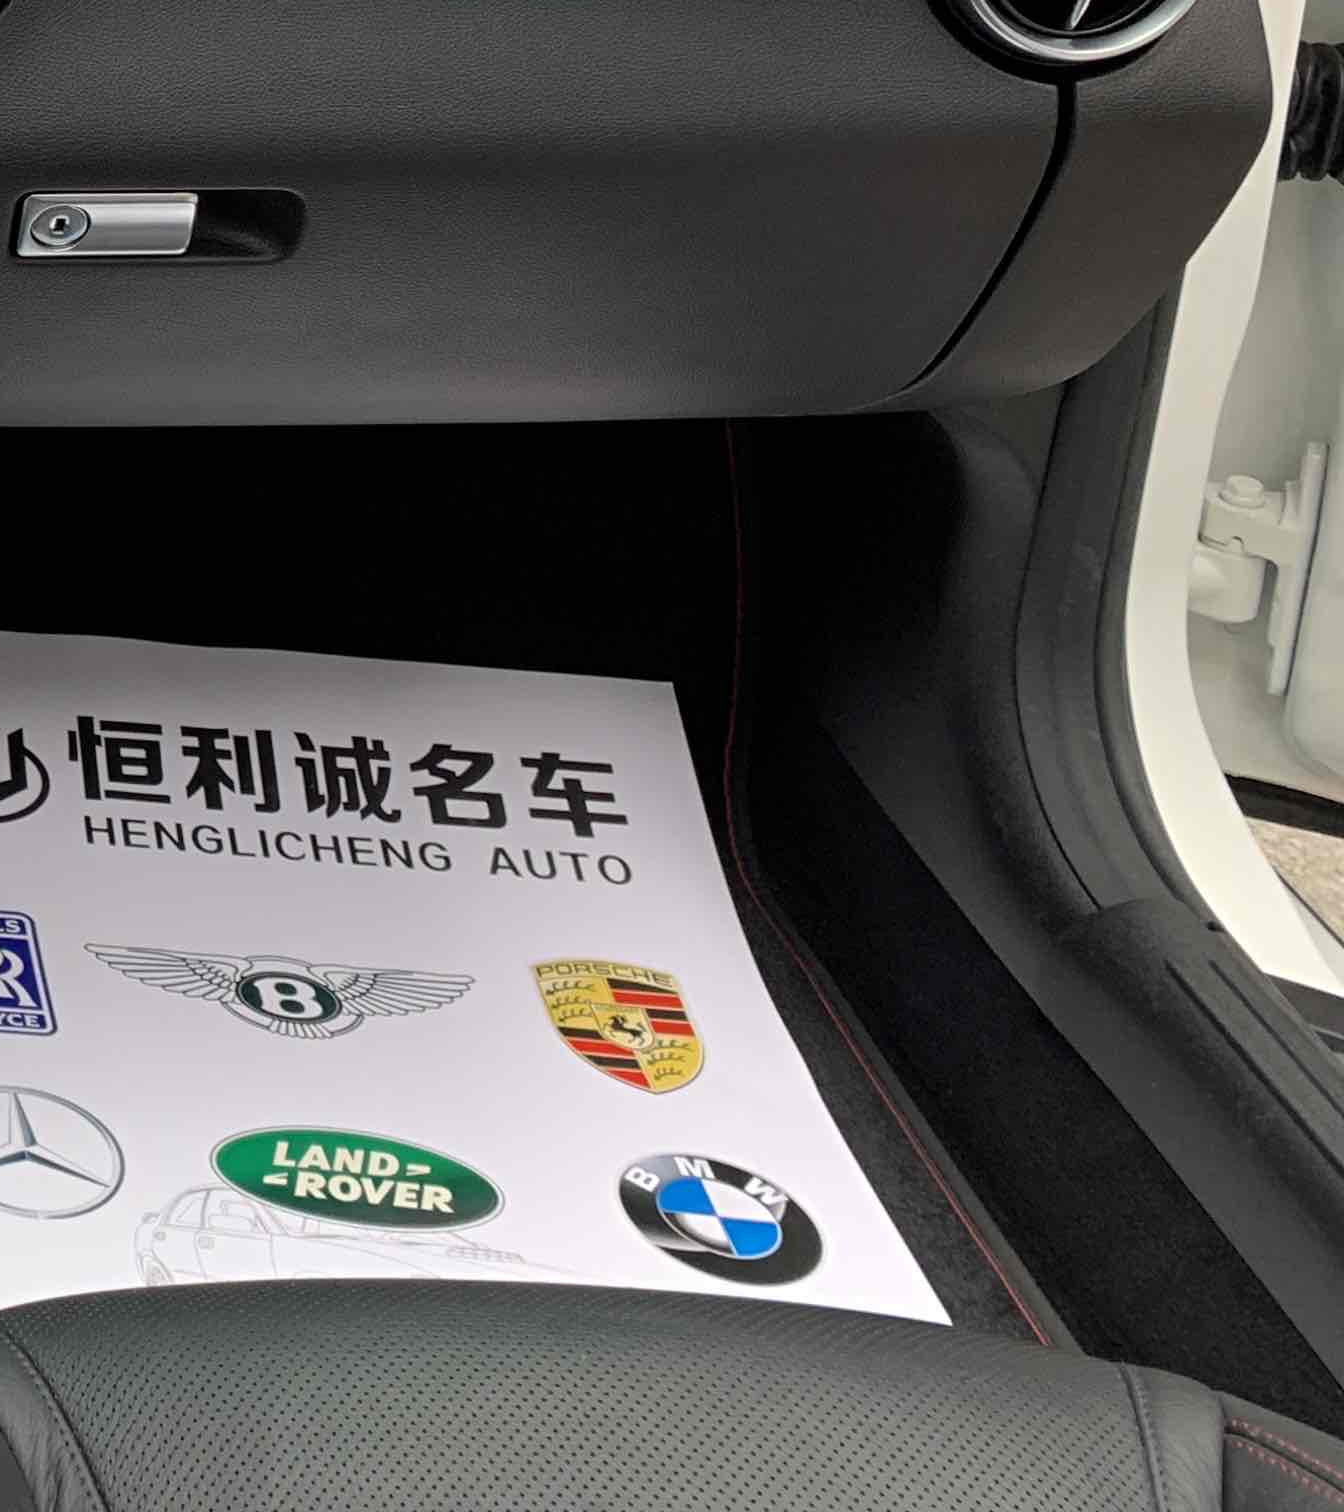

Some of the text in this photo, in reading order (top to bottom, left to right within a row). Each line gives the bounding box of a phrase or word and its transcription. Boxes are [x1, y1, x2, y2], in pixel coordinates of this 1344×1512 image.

[67, 715, 628, 838] 恒利诚名车
[84, 815, 632, 886] HENGLICHENG AUTO
[535, 962, 673, 988] PORSCHE
[293, 1172, 455, 1213] ROVER
[624, 1156, 789, 1206] BMW
